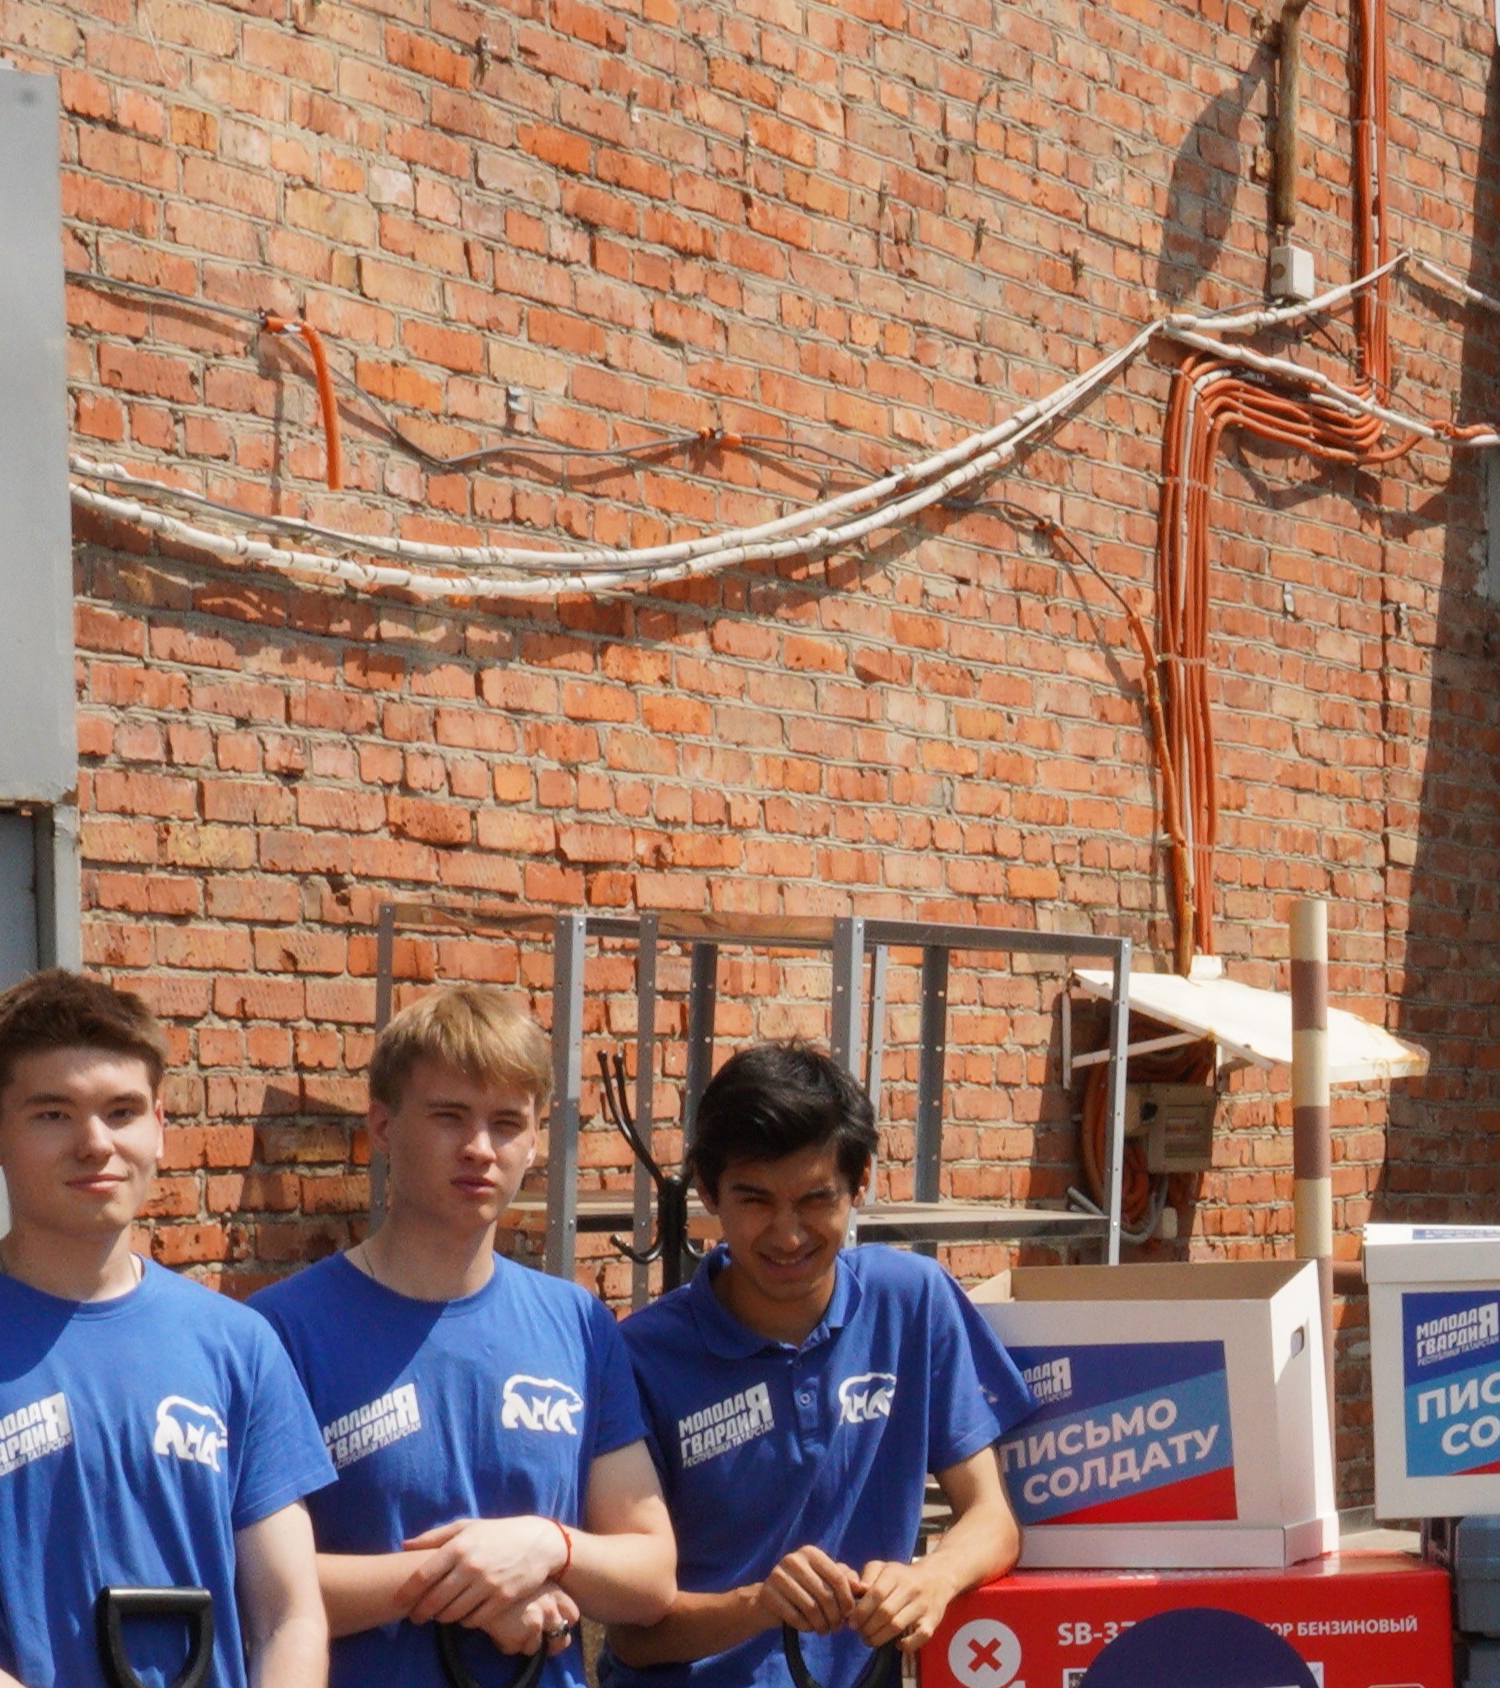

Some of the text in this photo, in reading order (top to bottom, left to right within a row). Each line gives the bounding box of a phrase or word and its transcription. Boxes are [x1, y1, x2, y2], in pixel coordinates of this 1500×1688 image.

[1416, 1302, 1498, 1339] МОЛОДАЯ
[323, 1383, 419, 1444] МОЛОДАЯ
[679, 1382, 773, 1438] МОЛОДАЯ
[1000, 1399, 1177, 1473] ПИСЬМО
[1023, 1424, 1219, 1504] СОЛДАТУ
[1297, 1617, 1418, 1638] БЕНЗИНОВЫЙ
